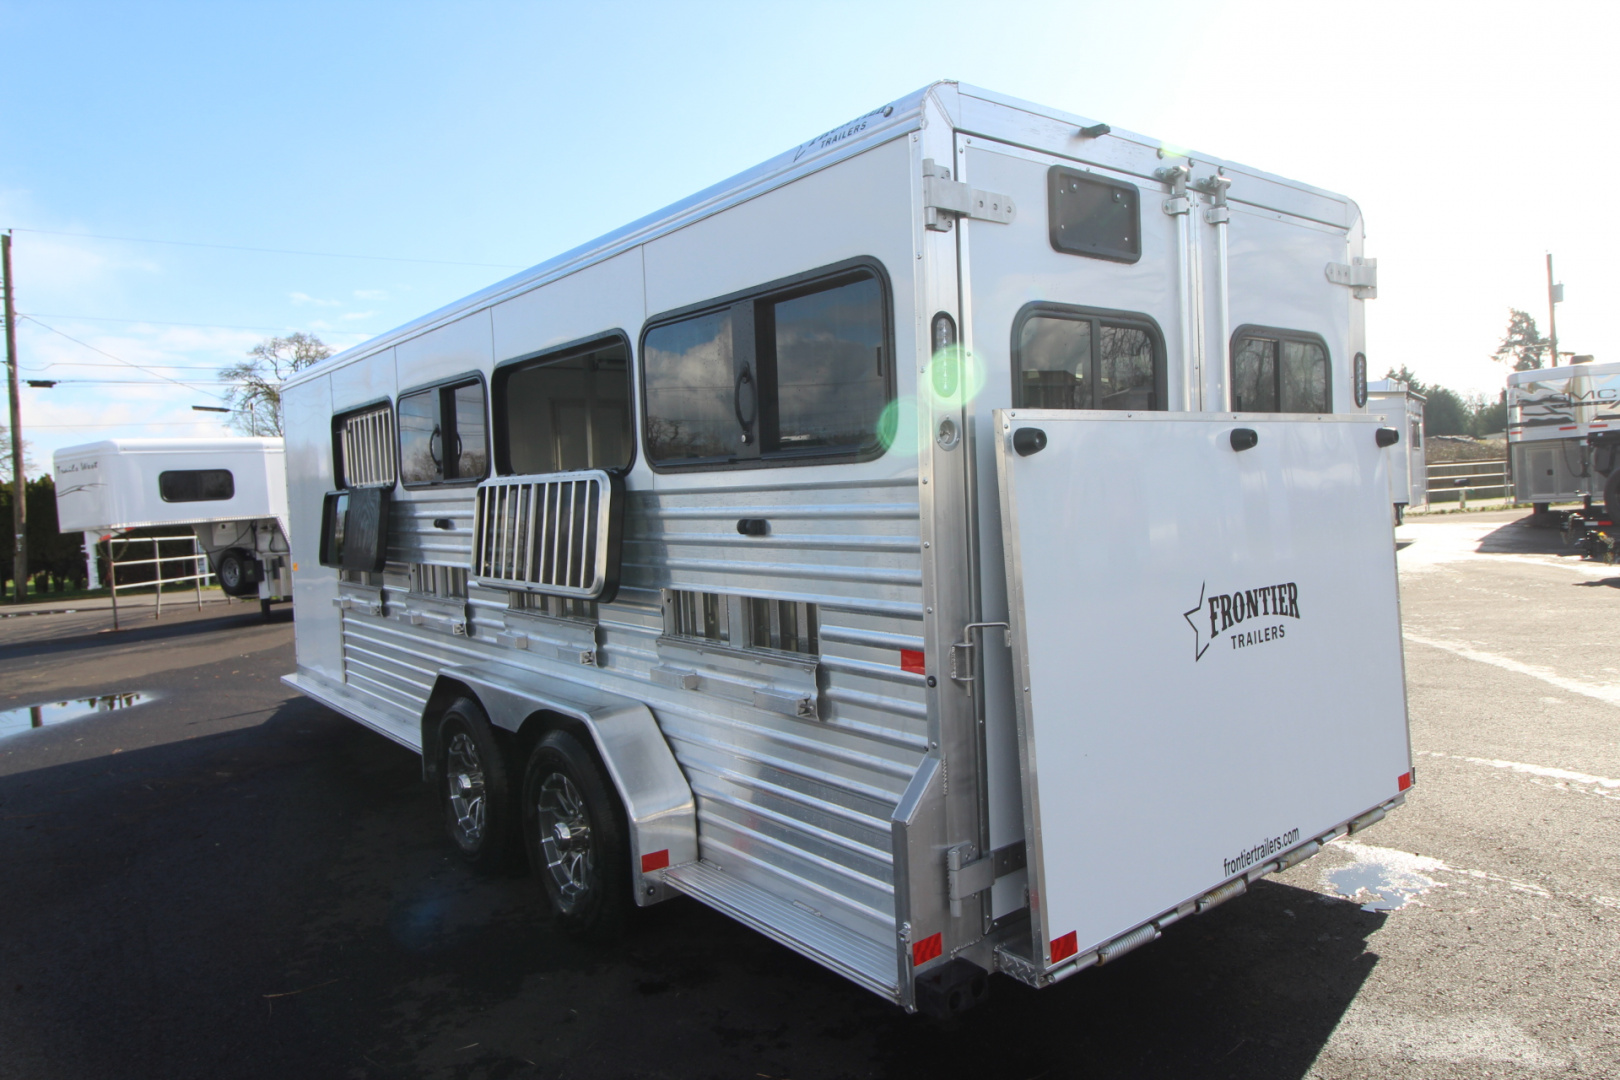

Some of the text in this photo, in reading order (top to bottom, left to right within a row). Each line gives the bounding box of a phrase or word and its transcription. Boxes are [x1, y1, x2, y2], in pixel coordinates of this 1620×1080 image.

[820, 121, 867, 149] TRAILERS
[1208, 581, 1300, 640] FRONTIER
[1231, 624, 1285, 650] TRAILERS
[1223, 827, 1300, 877] frontiertrailers.com
